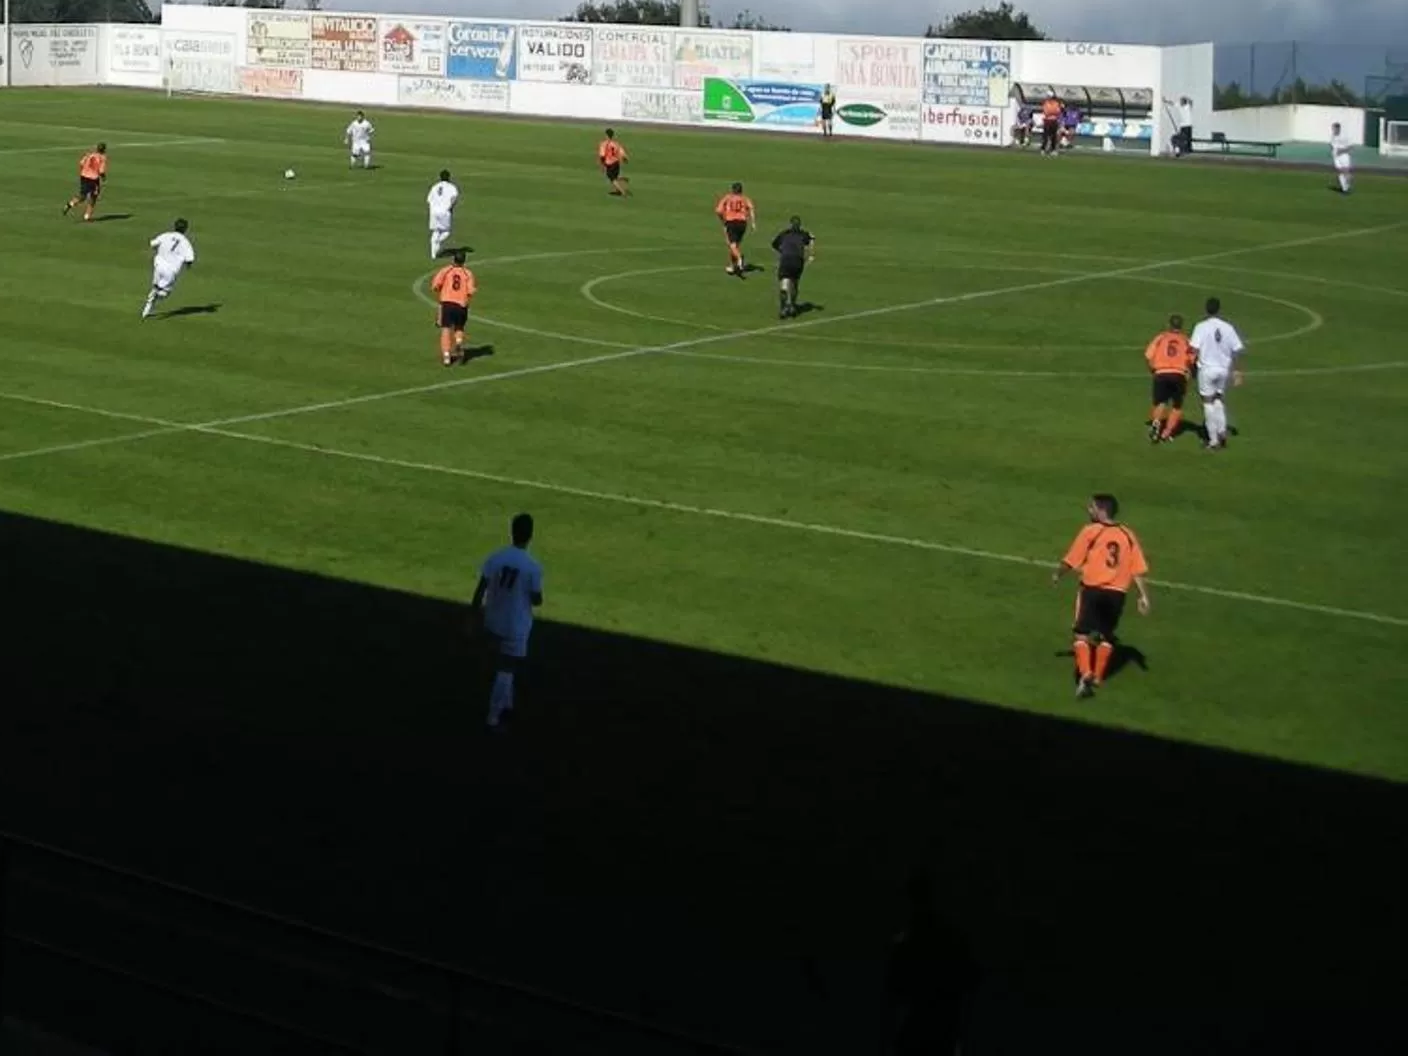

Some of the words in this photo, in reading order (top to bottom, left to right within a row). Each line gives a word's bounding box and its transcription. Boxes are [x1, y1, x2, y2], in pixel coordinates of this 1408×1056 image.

[449, 22, 508, 45] Coronita
[598, 30, 668, 45] COMERCIAL
[449, 45, 501, 58] cerveza
[527, 41, 586, 58] VALIDO
[850, 44, 910, 62] SPORT
[1066, 42, 1115, 57] LOCAL
[923, 107, 999, 126] iberfusión
[1105, 541, 1120, 568] 3
